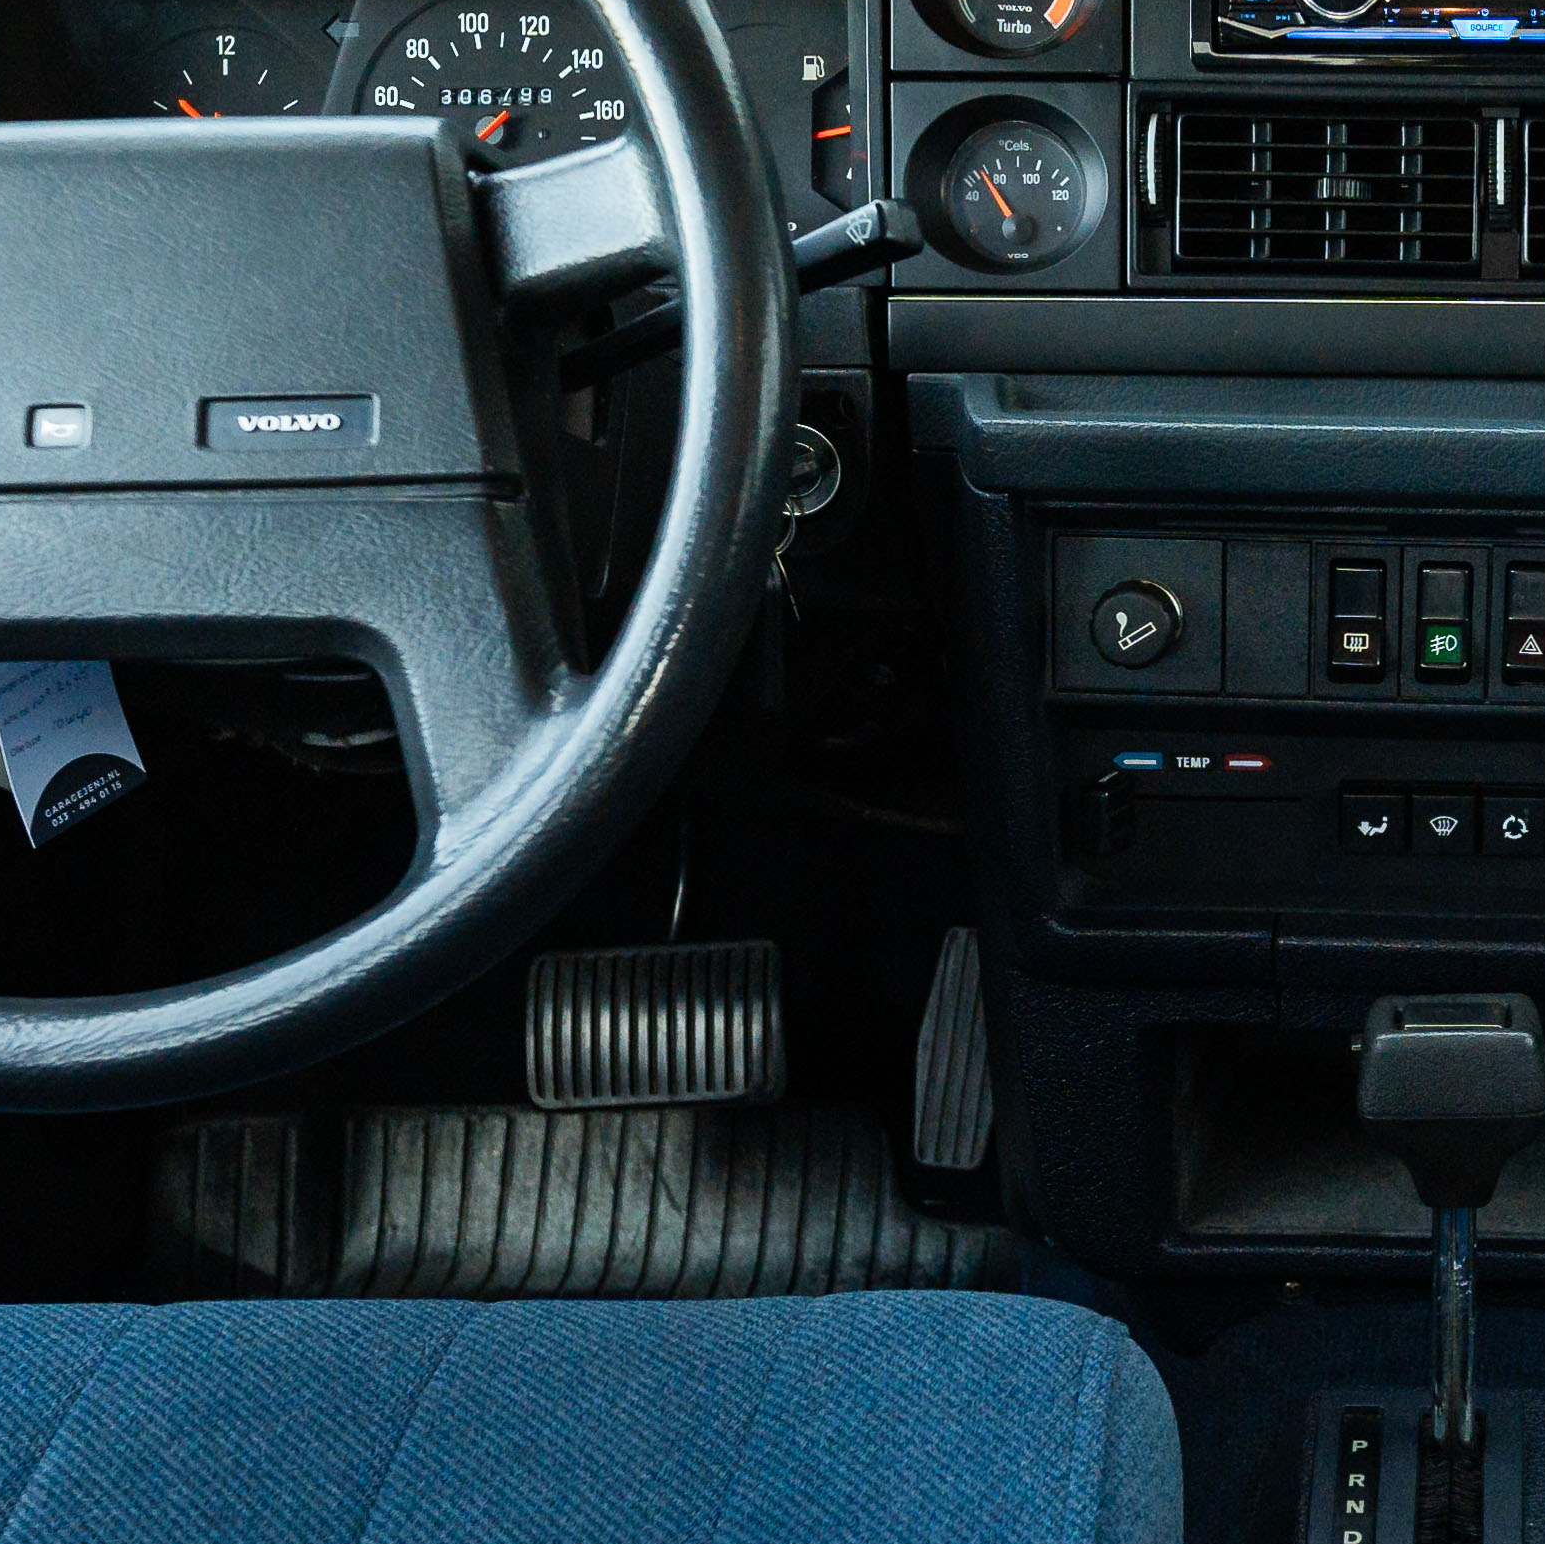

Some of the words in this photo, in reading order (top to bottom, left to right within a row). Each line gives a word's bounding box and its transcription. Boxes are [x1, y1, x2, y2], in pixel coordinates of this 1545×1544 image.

[997, 4, 1033, 12] VOLVO
[457, 13, 489, 33] 100
[519, 15, 550, 36] 120
[996, 18, 1032, 34] Turbo
[1470, 24, 1504, 32] SOURCE
[215, 34, 236, 55] 12
[406, 38, 430, 59] 80
[571, 48, 604, 69] 140
[374, 86, 398, 106] 60
[593, 99, 625, 121] 160
[992, 173, 1007, 185] 80
[1022, 173, 1041, 185] 100
[965, 190, 980, 202] 40
[1051, 189, 1070, 201] 120
[237, 413, 343, 433] VOLVO
[1175, 756, 1211, 768] TEMP
[44, 769, 121, 818] GARAGEJENJ.NL
[51, 812, 69, 827] 033
[79, 796, 97, 810] 494
[99, 787, 111, 799] 01
[111, 780, 122, 791] 15
[1352, 1439, 1368, 1452] P
[1348, 1473, 1365, 1487] R
[1345, 1500, 1365, 1514] N
[1343, 1530, 1363, 1544] D
